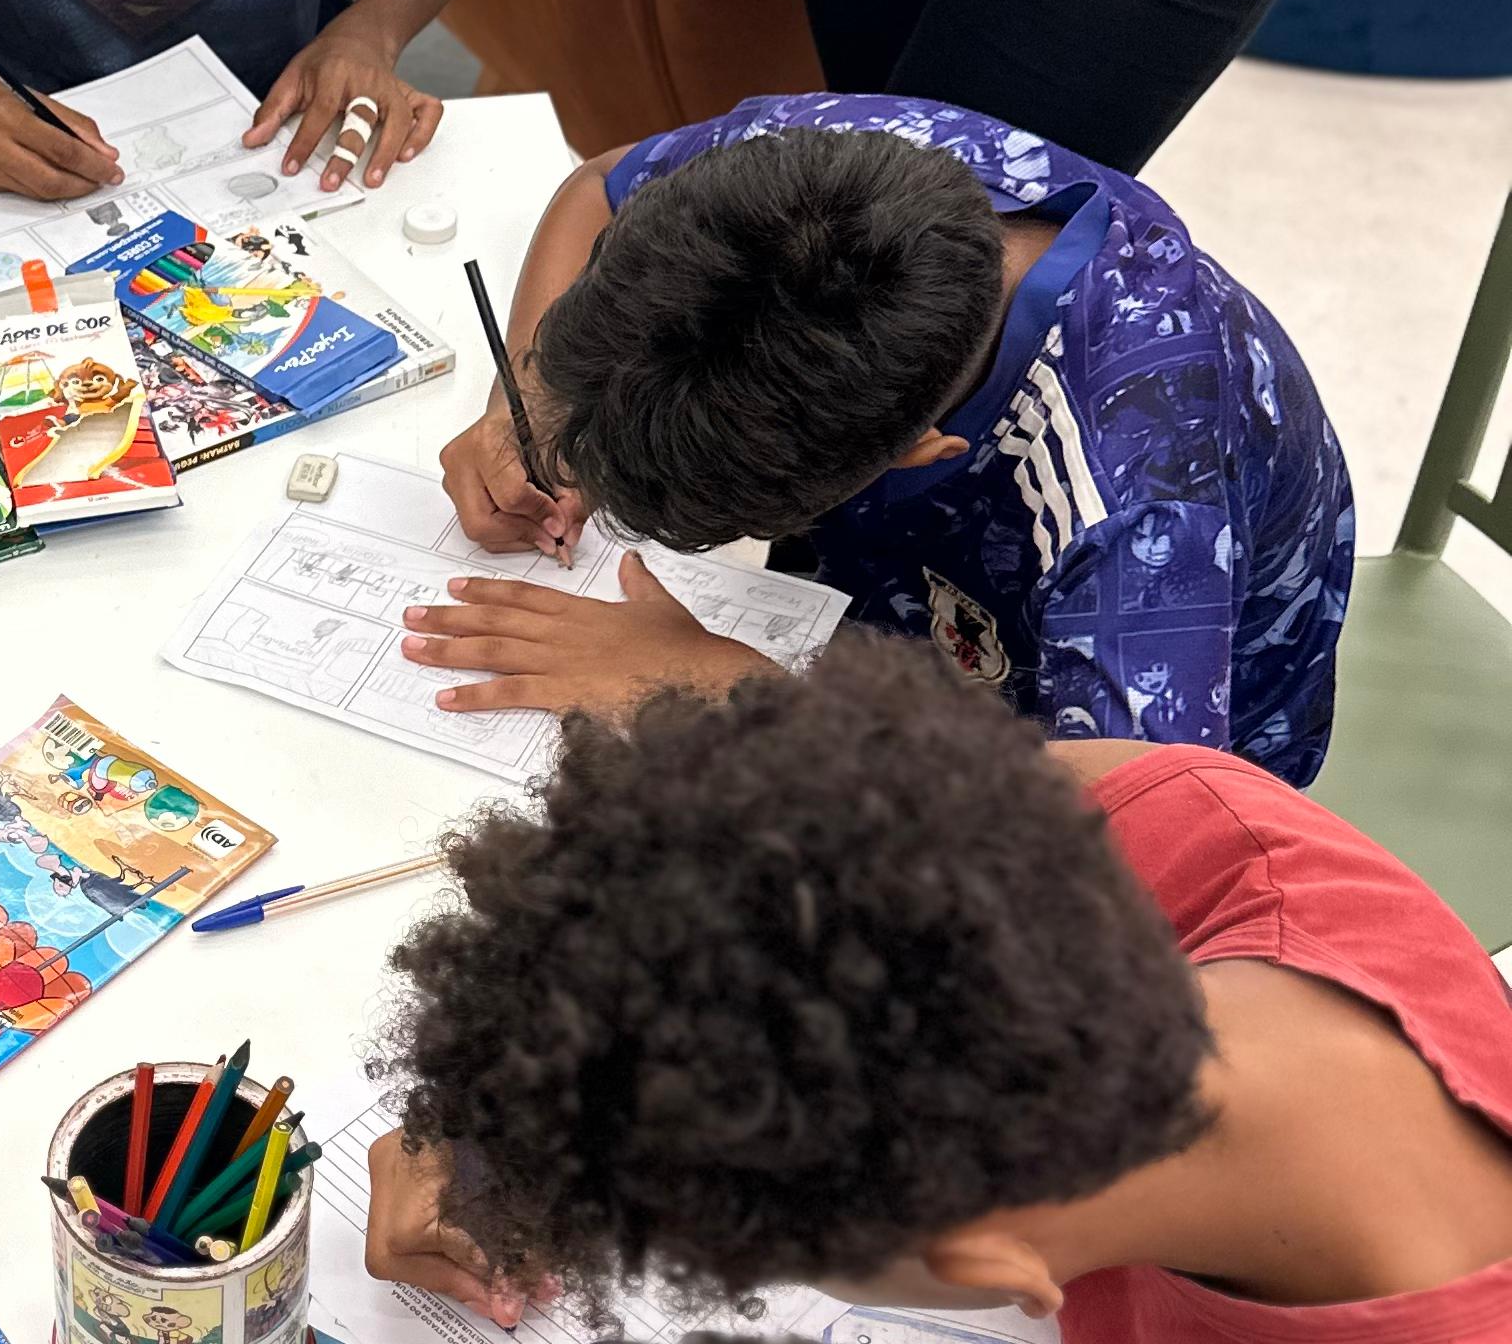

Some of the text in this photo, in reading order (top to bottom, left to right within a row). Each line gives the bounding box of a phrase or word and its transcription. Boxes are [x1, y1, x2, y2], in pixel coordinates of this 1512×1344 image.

[116, 232, 165, 262] 12 CORES
[46, 323, 68, 337] DE
[75, 315, 112, 331] COR
[273, 325, 356, 374] InjexPen
[409, 1305, 421, 1317] DO
[421, 1302, 431, 1312] DE
[442, 1309, 454, 1320] DO
[420, 1315, 448, 1339] ESTADO
[430, 1311, 458, 1336] ESTADO
[457, 1333, 468, 1343] DE
